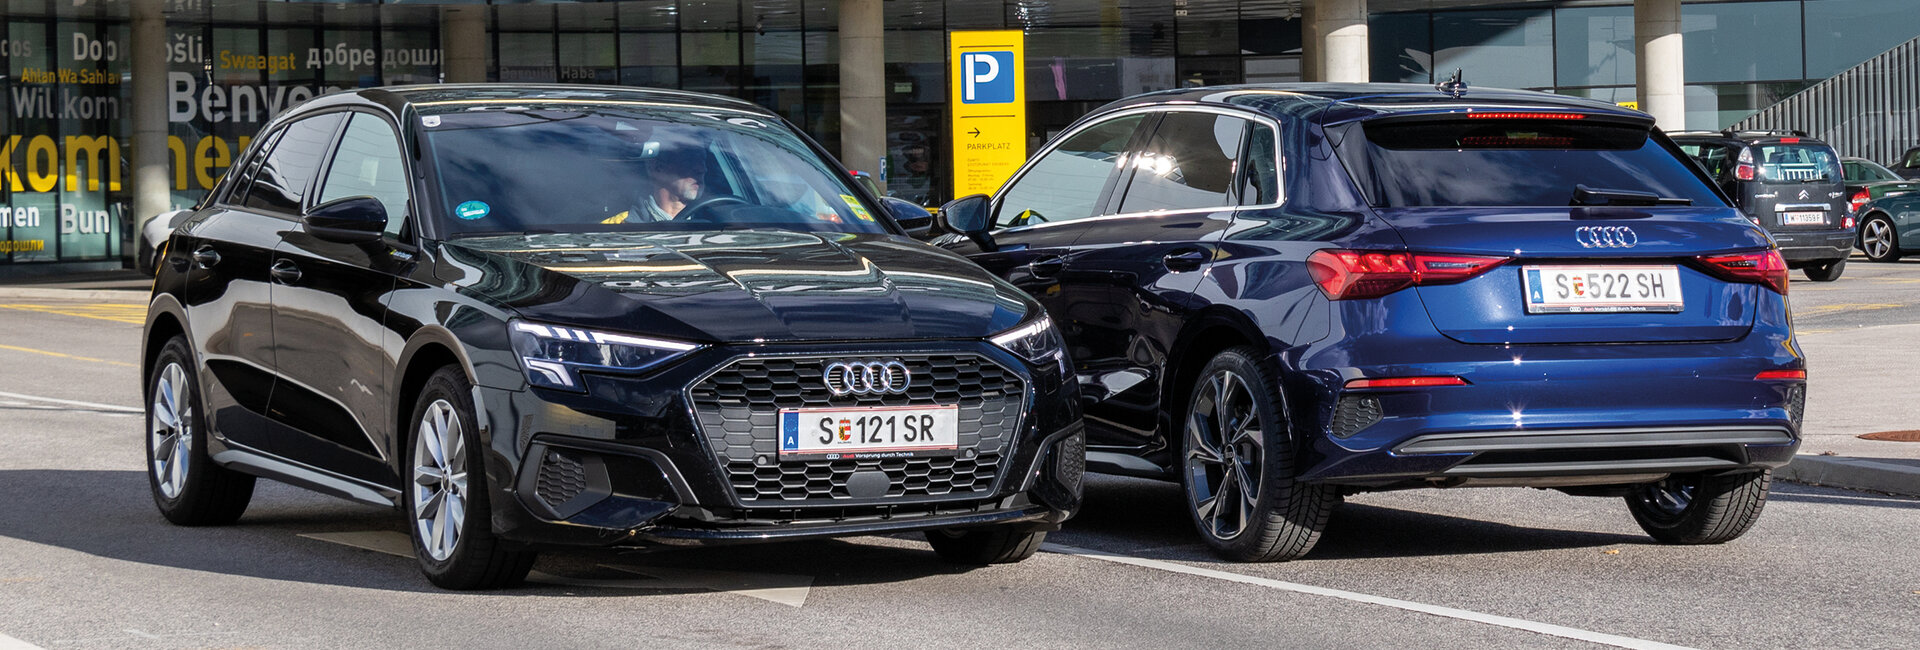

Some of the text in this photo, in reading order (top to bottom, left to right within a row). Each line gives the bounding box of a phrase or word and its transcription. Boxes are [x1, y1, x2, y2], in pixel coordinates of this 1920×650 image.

[219, 50, 296, 74] Swaagat
[306, 42, 376, 71] добре
[21, 67, 56, 84] Ahlan
[57, 69, 78, 84] Wa
[561, 66, 596, 80] Haba
[965, 53, 999, 101] P
[966, 142, 1011, 151] PARKPLATZ
[880, 158, 887, 174] P
[61, 203, 110, 234] Bun
[1534, 291, 1541, 299] A
[1556, 273, 1666, 299] S 522 SH
[819, 414, 935, 446] S 121 SR
[787, 436, 795, 446] A
